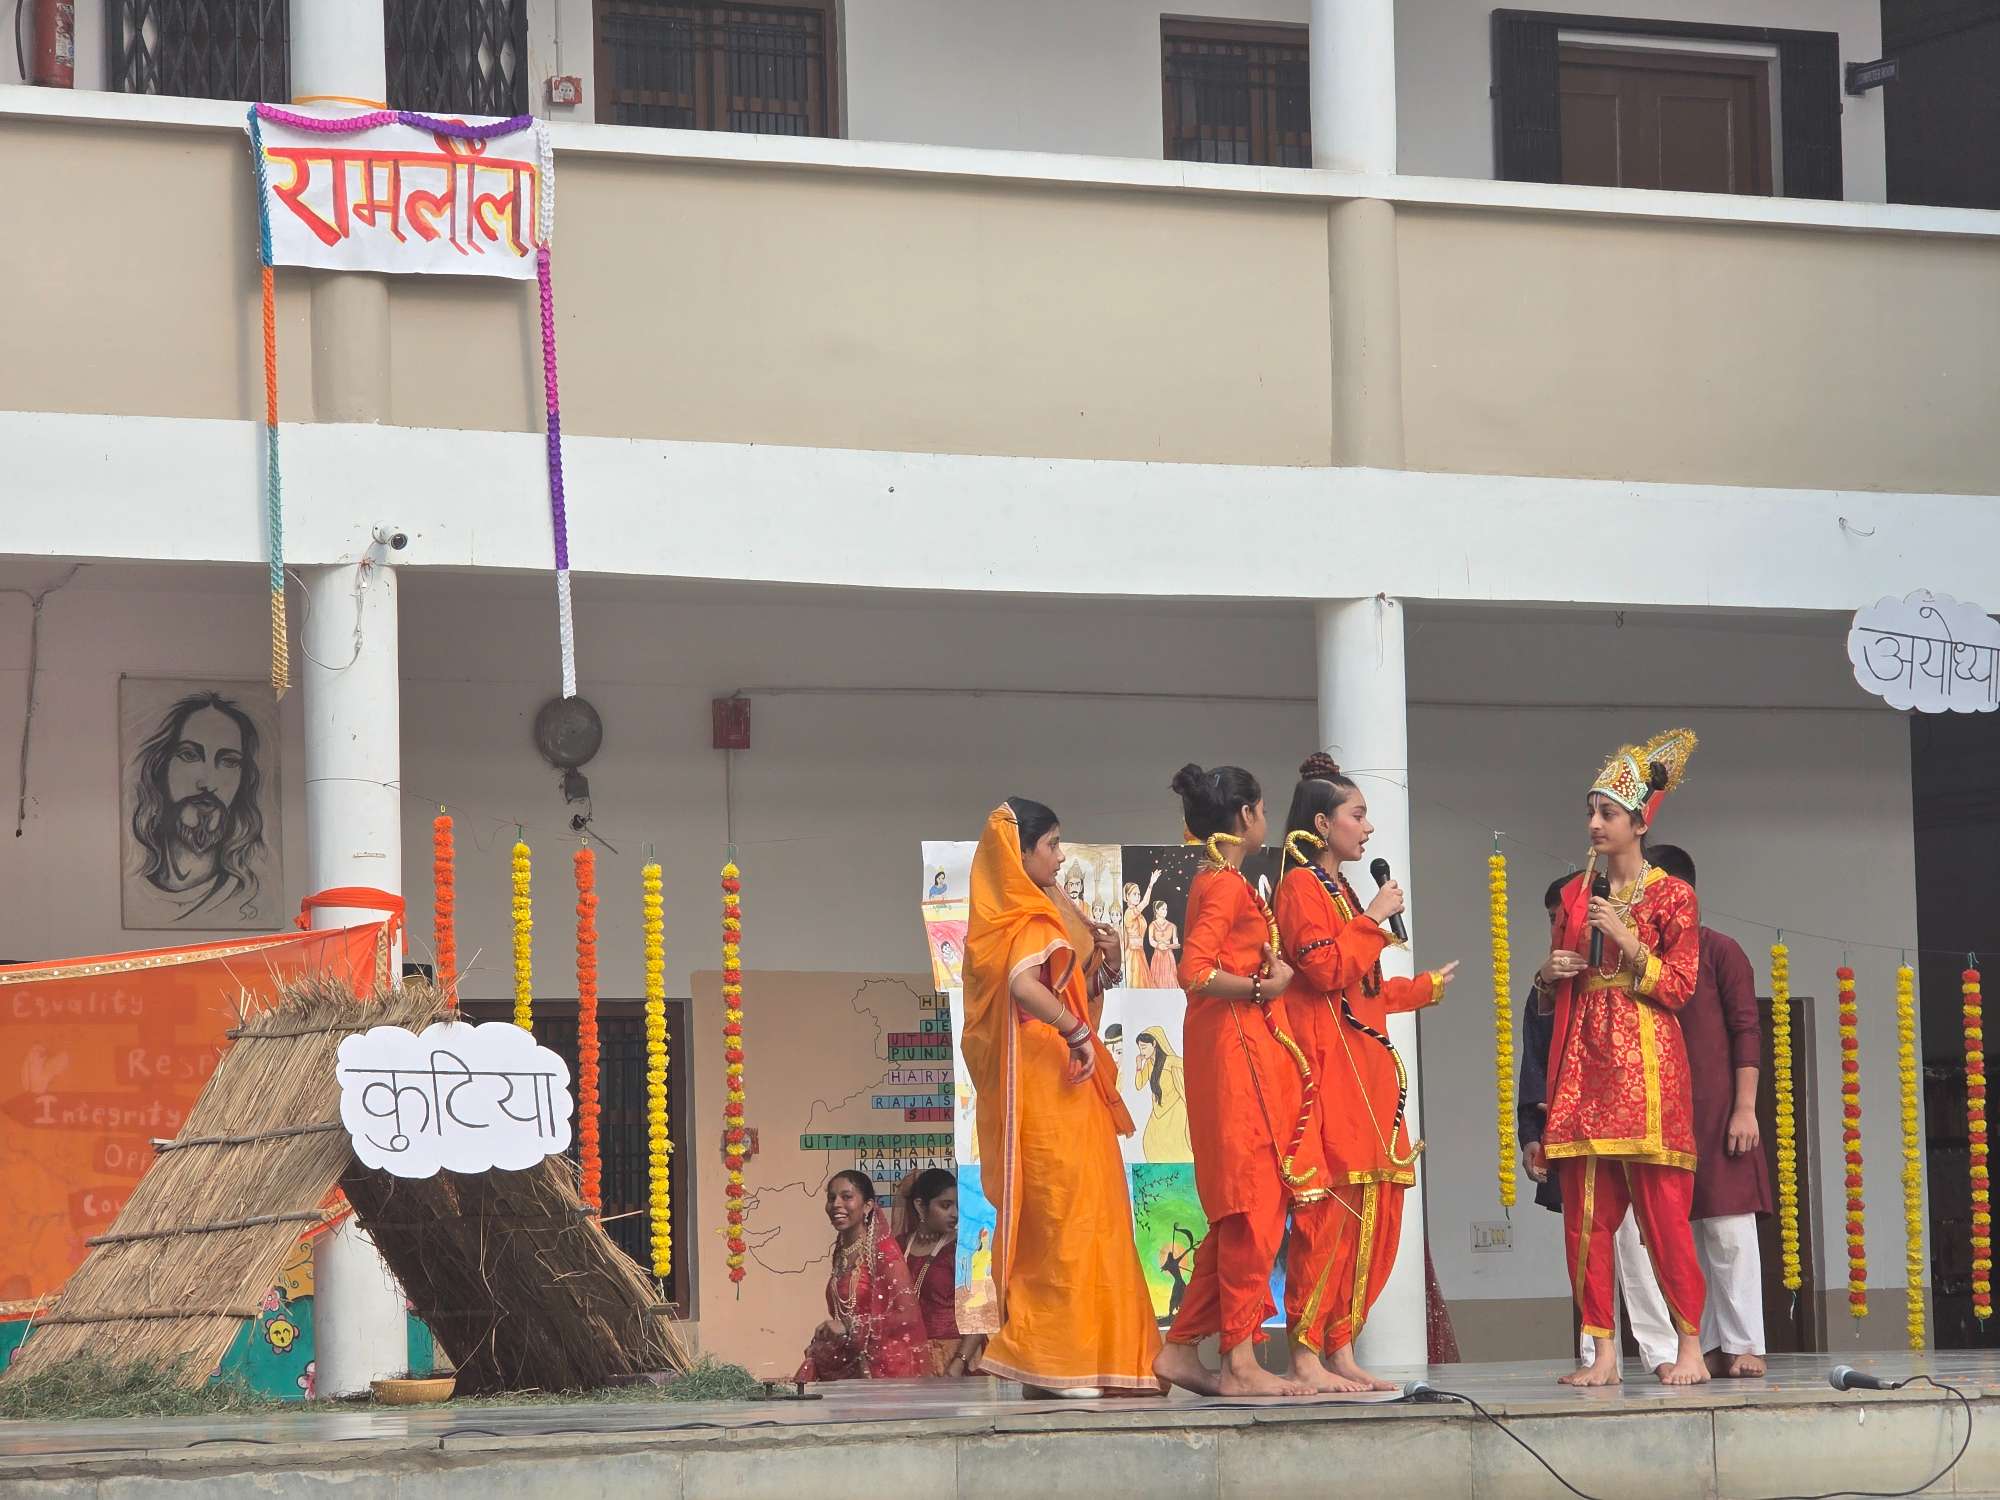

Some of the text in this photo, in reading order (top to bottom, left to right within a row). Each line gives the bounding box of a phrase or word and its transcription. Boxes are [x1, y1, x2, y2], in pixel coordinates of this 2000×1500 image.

[1858, 606, 2000, 704] अयोध्या
[12, 987, 144, 1018] Equality
[891, 1070, 949, 1082] HARY
[33, 1095, 181, 1128] Integrity
[344, 1049, 558, 1153] कुटिया
[875, 1095, 951, 1109] RAJAS
